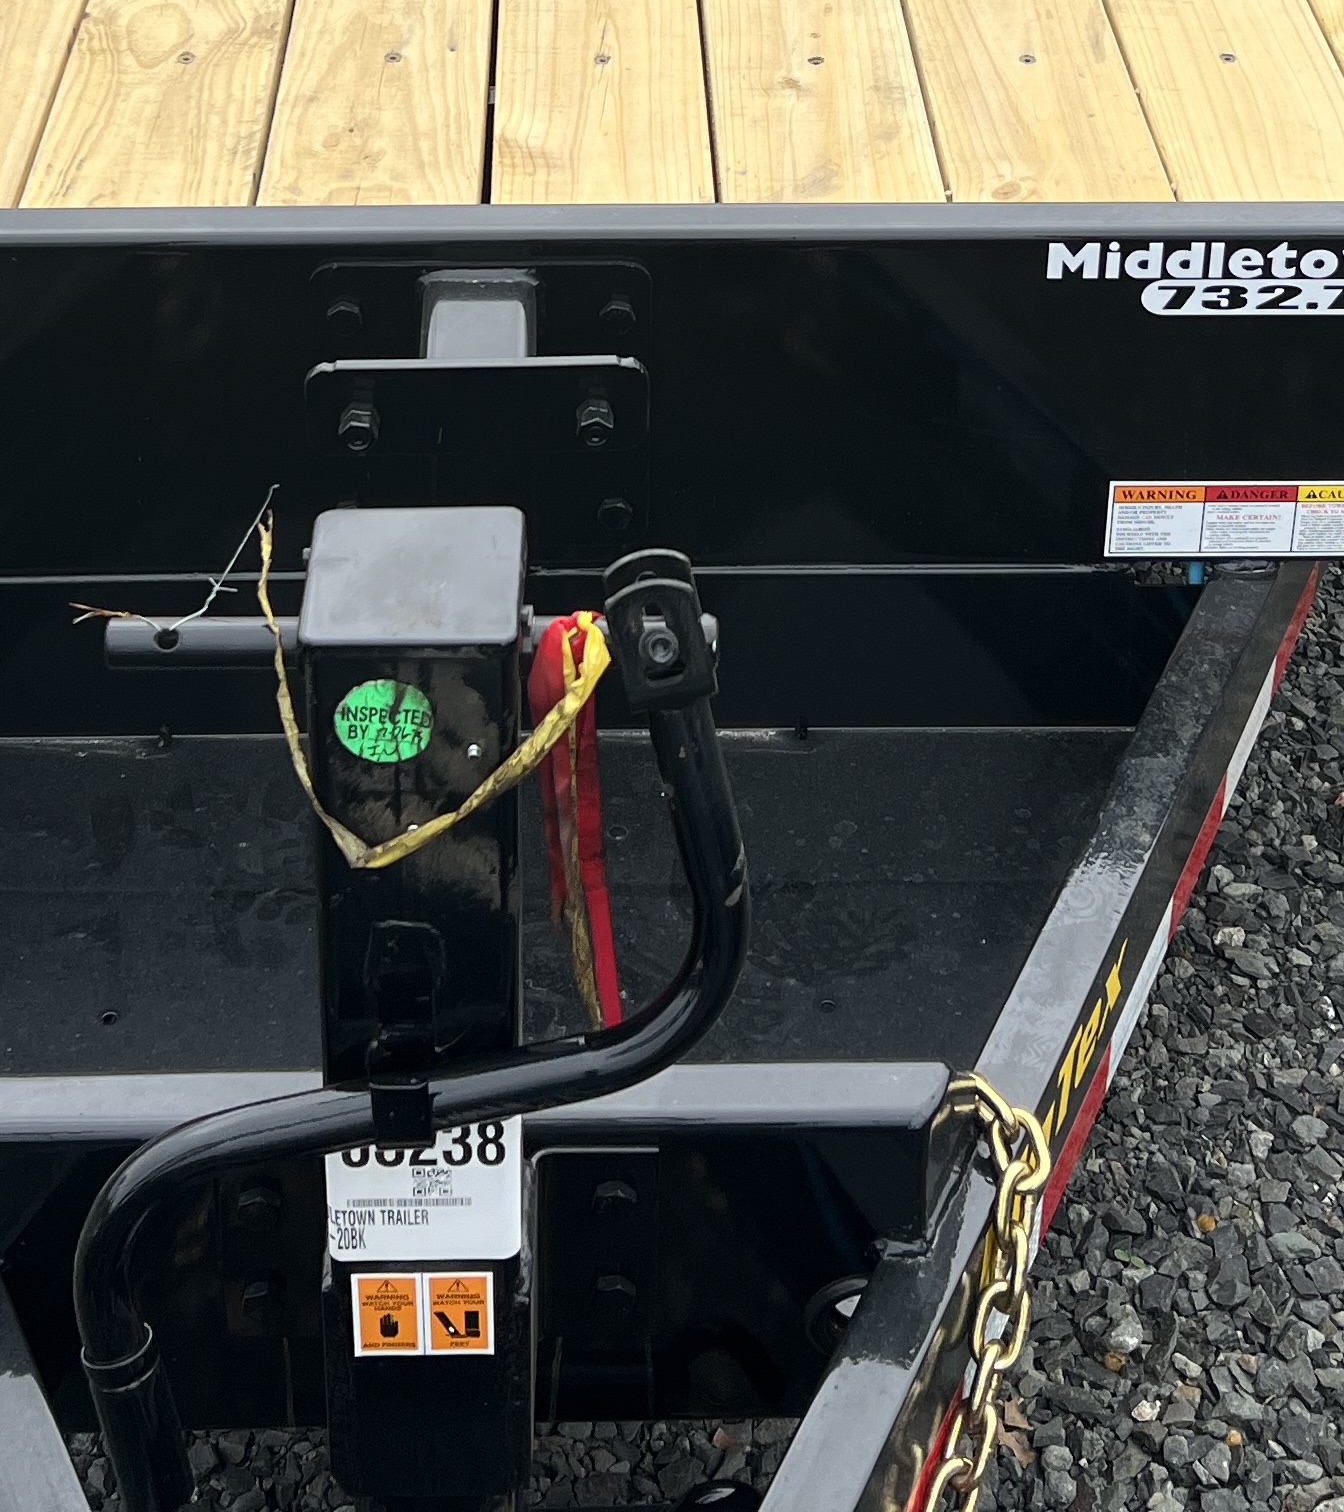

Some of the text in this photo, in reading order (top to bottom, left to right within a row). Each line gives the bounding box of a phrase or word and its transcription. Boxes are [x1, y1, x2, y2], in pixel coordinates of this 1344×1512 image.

[1122, 490, 1197, 500] WARNING
[1230, 490, 1289, 499] DANGER
[341, 706, 432, 728] INSPECTED
[347, 724, 369, 739] BY
[380, 1209, 429, 1226] TRAILER
